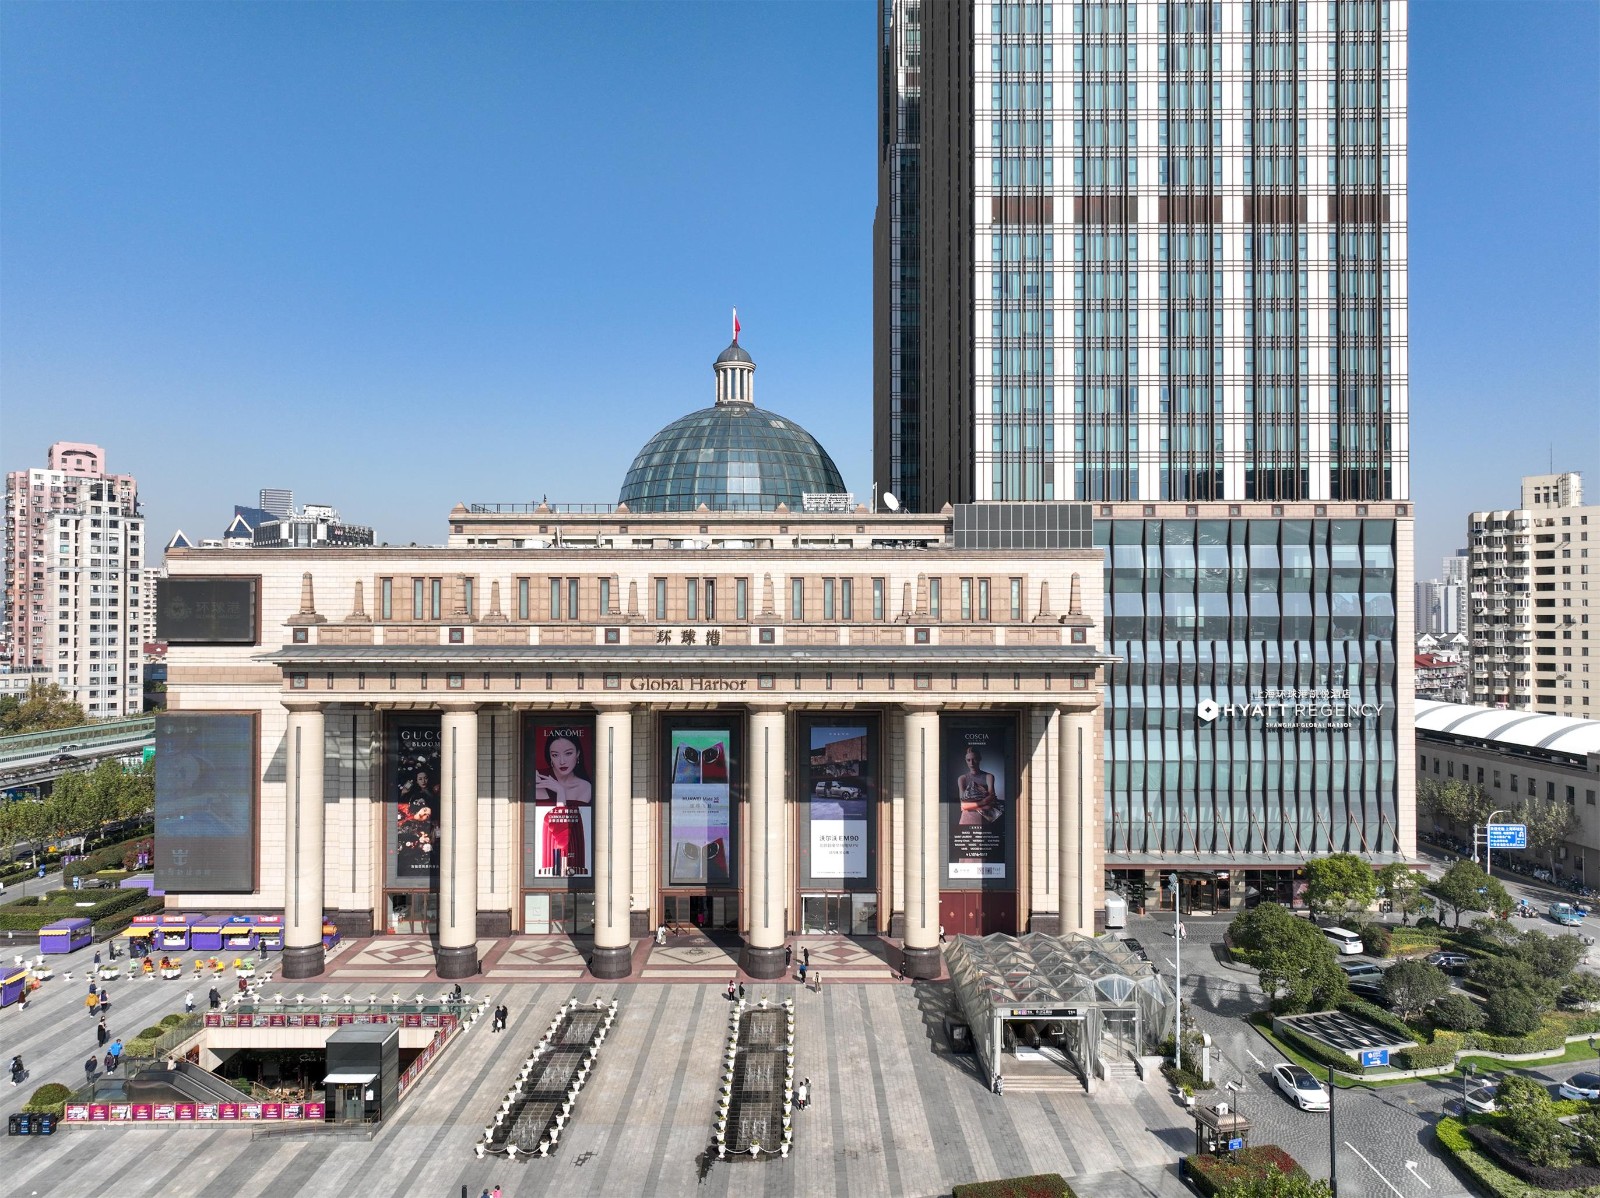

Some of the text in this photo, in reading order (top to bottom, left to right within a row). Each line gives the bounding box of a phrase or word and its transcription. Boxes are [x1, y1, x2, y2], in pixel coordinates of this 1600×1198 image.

[656, 628, 721, 646] 环球港
[630, 674, 747, 691] Global Harbor
[1254, 688, 1351, 699] 上海环球港凯悦酒店
[1223, 703, 1385, 717] HYATT REGENCY
[401, 730, 442, 740] GUCC
[543, 728, 585, 737] LANCÔME
[838, 834, 860, 842] EM90
